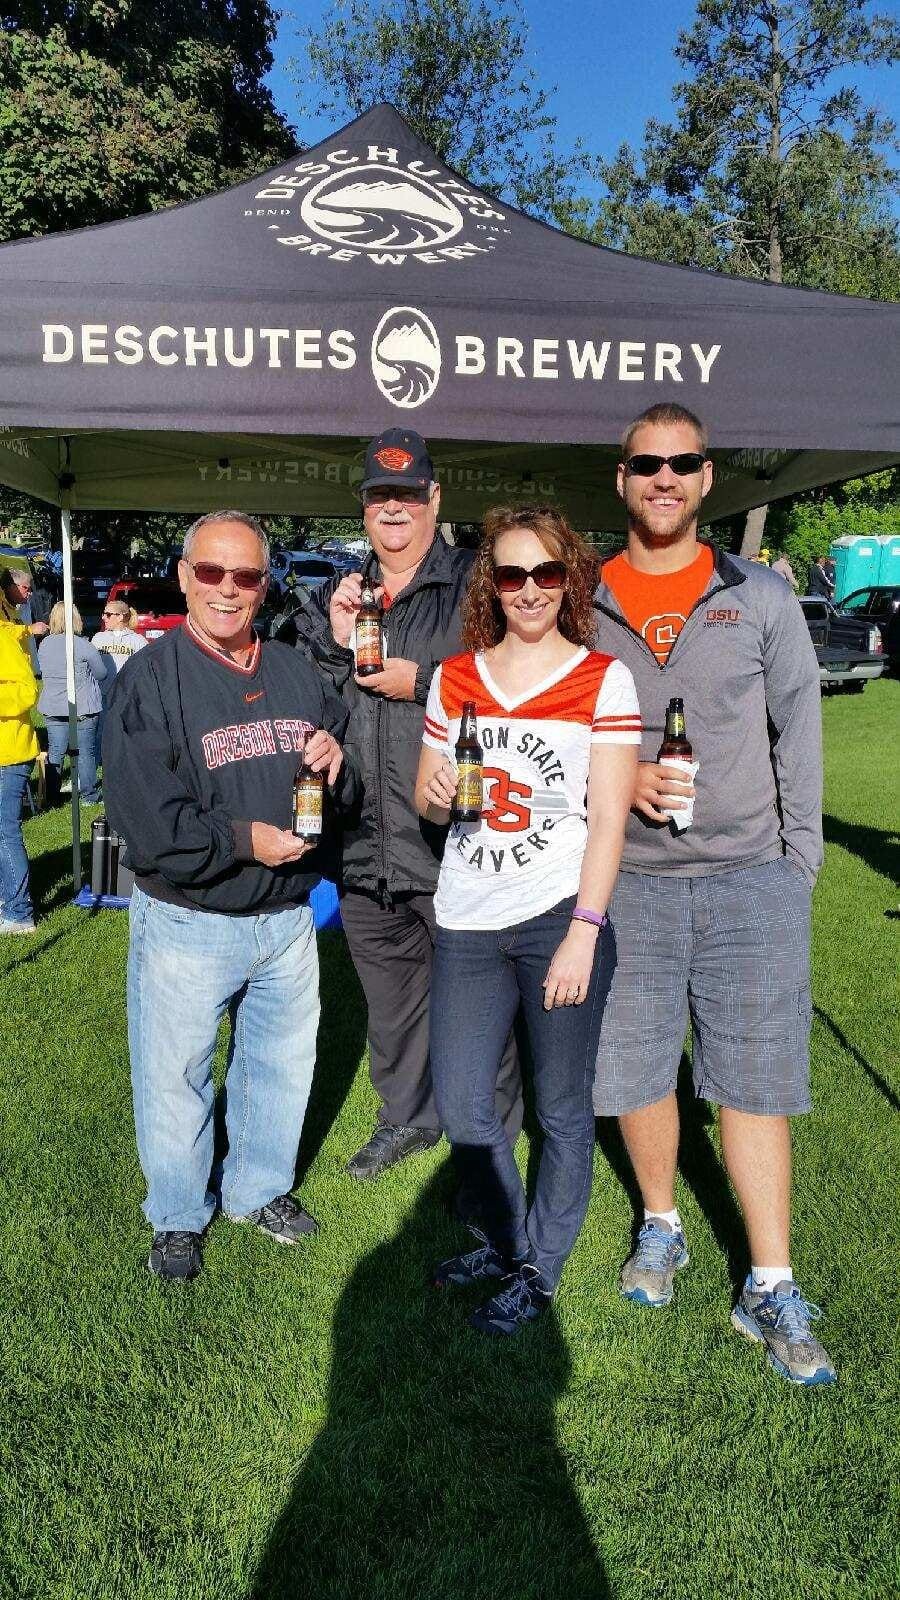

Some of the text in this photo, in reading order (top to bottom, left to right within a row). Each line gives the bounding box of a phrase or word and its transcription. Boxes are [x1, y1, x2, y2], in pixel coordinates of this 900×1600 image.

[255, 145, 506, 220] DESCHUTES
[277, 234, 490, 265] BREWERY
[41, 323, 722, 383] DESCHUTES BREWERY
[706, 609, 740, 622] OSU
[201, 719, 277, 770] OREGON
[516, 732, 565, 787] STATE
[454, 817, 556, 873] EAVER
